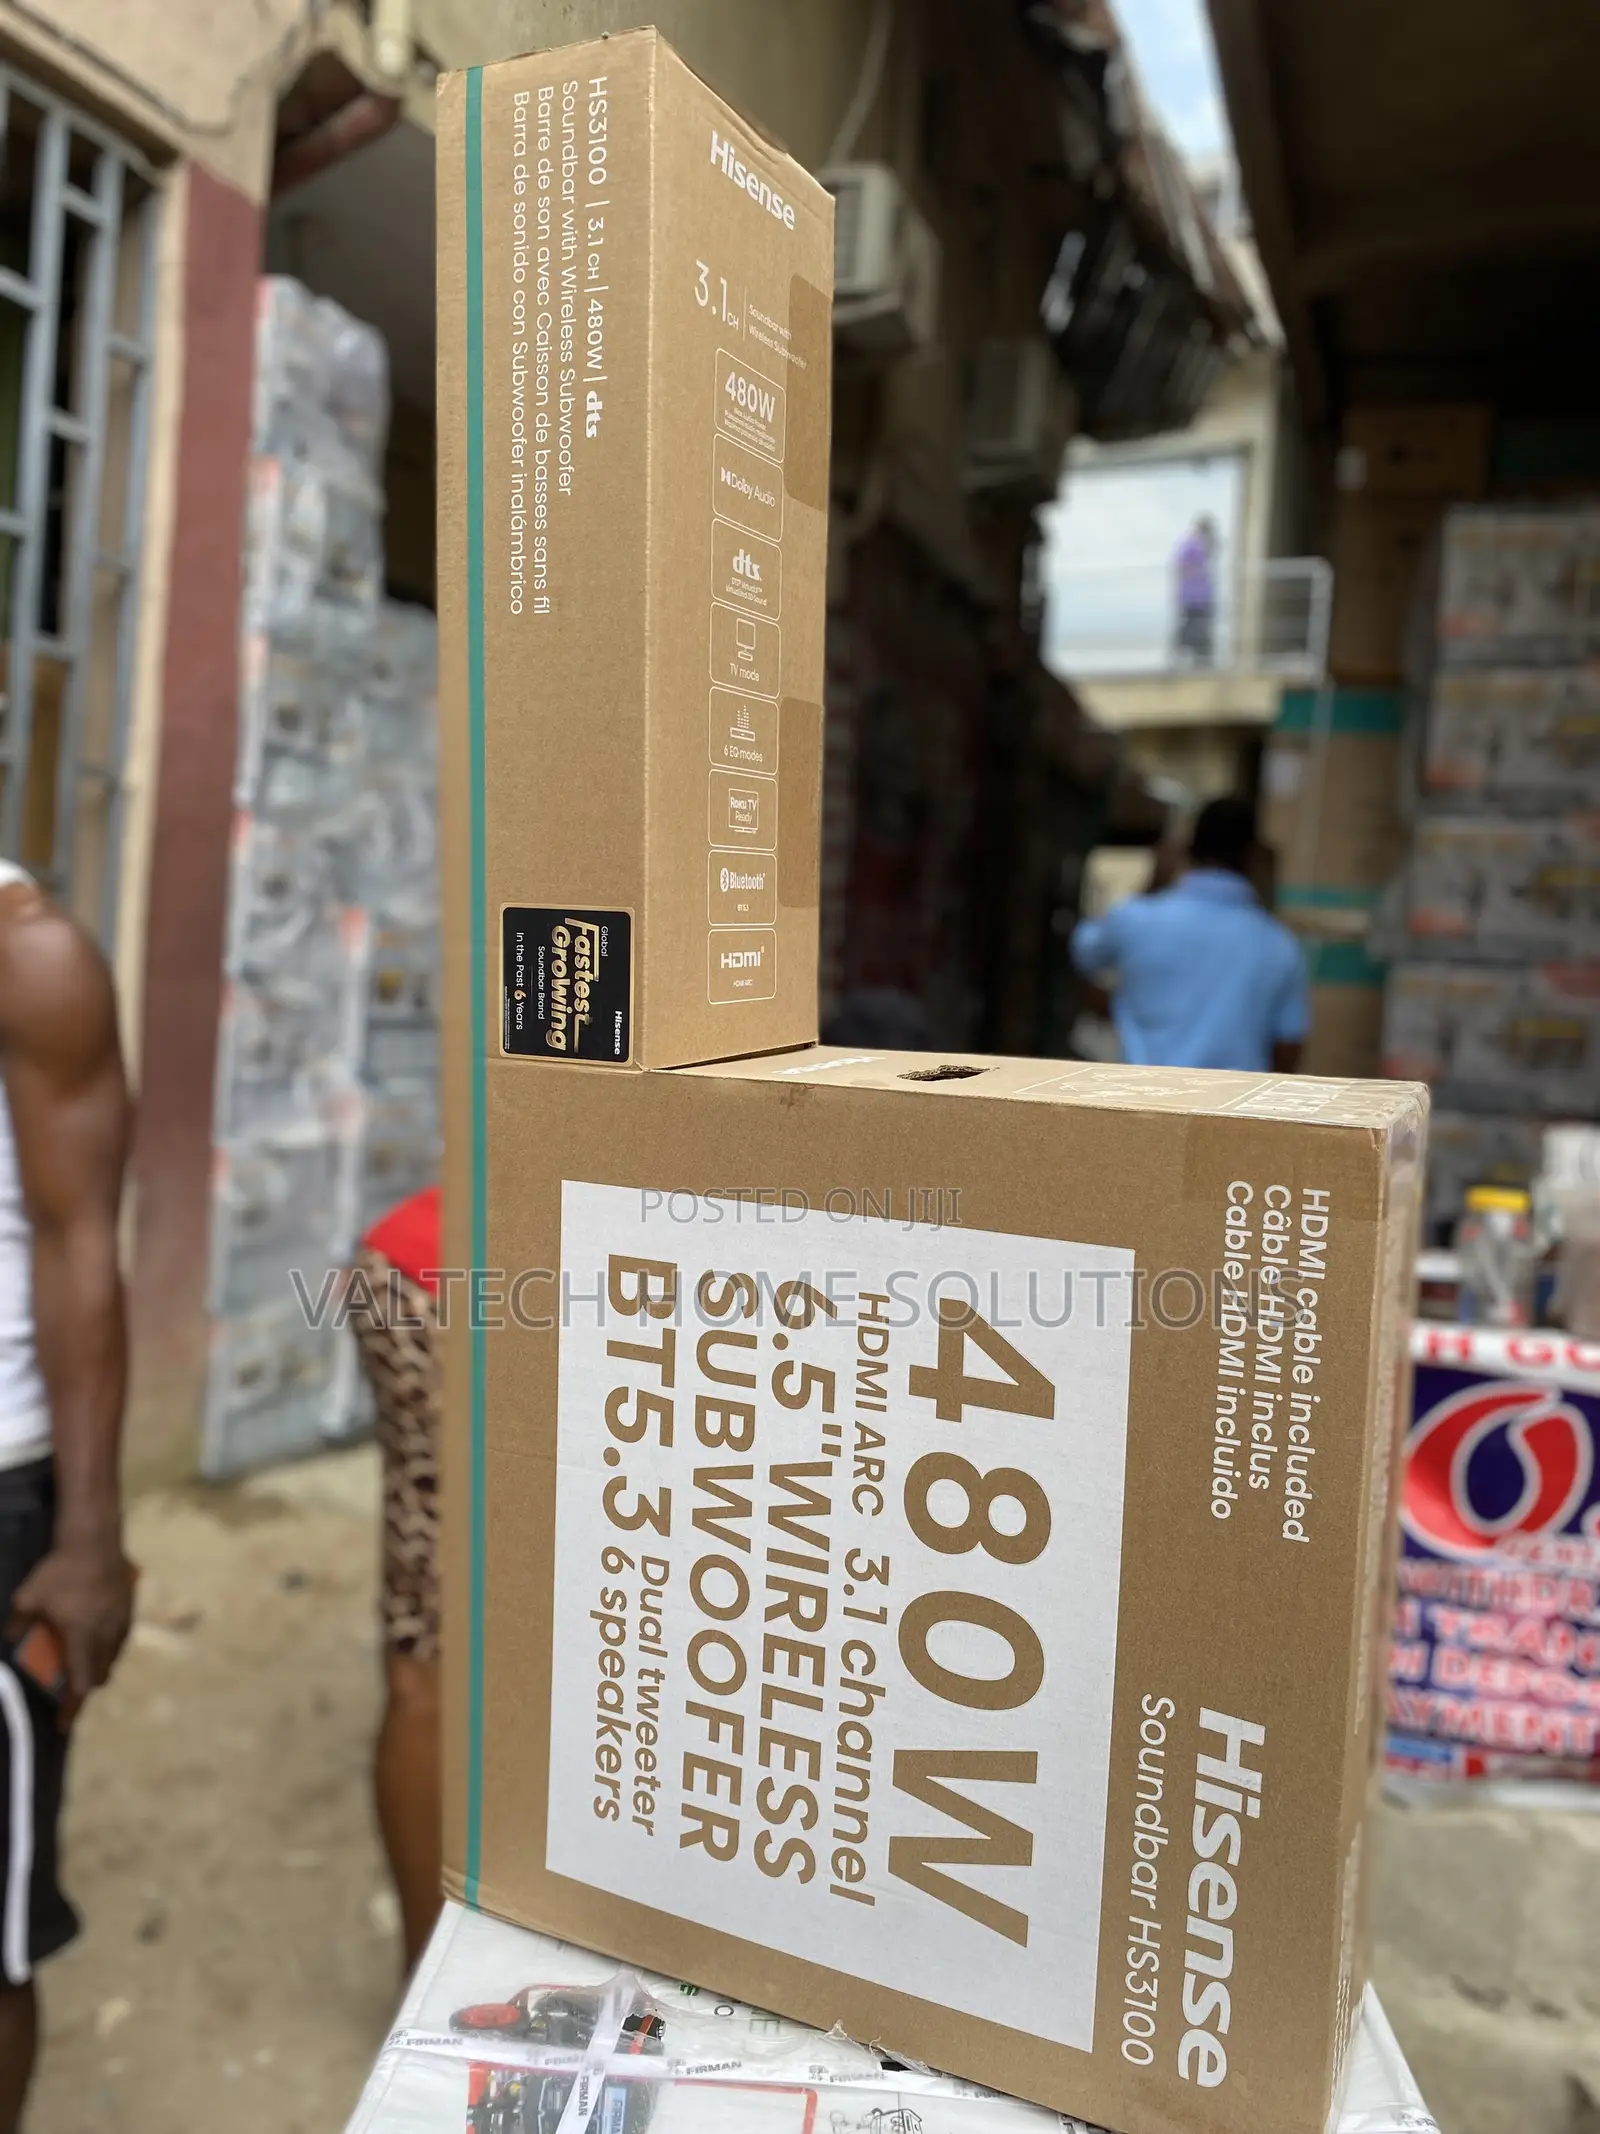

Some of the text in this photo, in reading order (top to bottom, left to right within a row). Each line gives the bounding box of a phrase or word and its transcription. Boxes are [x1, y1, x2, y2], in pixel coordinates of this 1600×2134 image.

[709, 130, 796, 231] Hisense
[558, 80, 578, 496] Soundbar with Wireless Subwoofer
[585, 76, 608, 438] HS3100 3.1 CH 480W dts
[510, 91, 530, 615] Barra de sonido con Subwoofer inalámbrico
[533, 86, 554, 614] Barre de son avec Caisson de basses sans fil
[725, 371, 775, 424] 480W
[731, 473, 776, 507] Dolby Audio
[732, 548, 761, 581] dts
[730, 662, 760, 682] TV mode
[723, 744, 763, 763] 6 EQ modes
[735, 811, 753, 825] Ready
[513, 932, 527, 1030] In the Past 6 Years
[537, 946, 546, 1020] Soundbar Brand
[564, 917, 600, 1053] Fastest
[600, 926, 609, 957] Global
[720, 950, 761, 969] HDMI
[614, 1010, 623, 1055] Hisense
[602, 1253, 678, 1538] BT5.3
[1210, 1180, 1254, 1520] Cable HDMI incluido
[1248, 1184, 1292, 1490] Câble HDMI inclus
[1282, 1187, 1330, 1544] HDMI cable included
[679, 1268, 759, 1862] SUBWOOFER
[829, 1291, 891, 1907] HDMI ARC 3.1 channel
[888, 1297, 1056, 1949] 480W
[590, 1545, 635, 1823] 6 speakers
[631, 1553, 670, 1837] Dual tweeter
[1120, 1693, 1176, 2066] Soundbar HS3100
[1177, 1706, 1266, 2089] Hisense
[406, 2036, 464, 2046] FIRMAN
[578, 2076, 590, 2116] FIRMAN
[686, 2061, 743, 2075] FIRMAN
